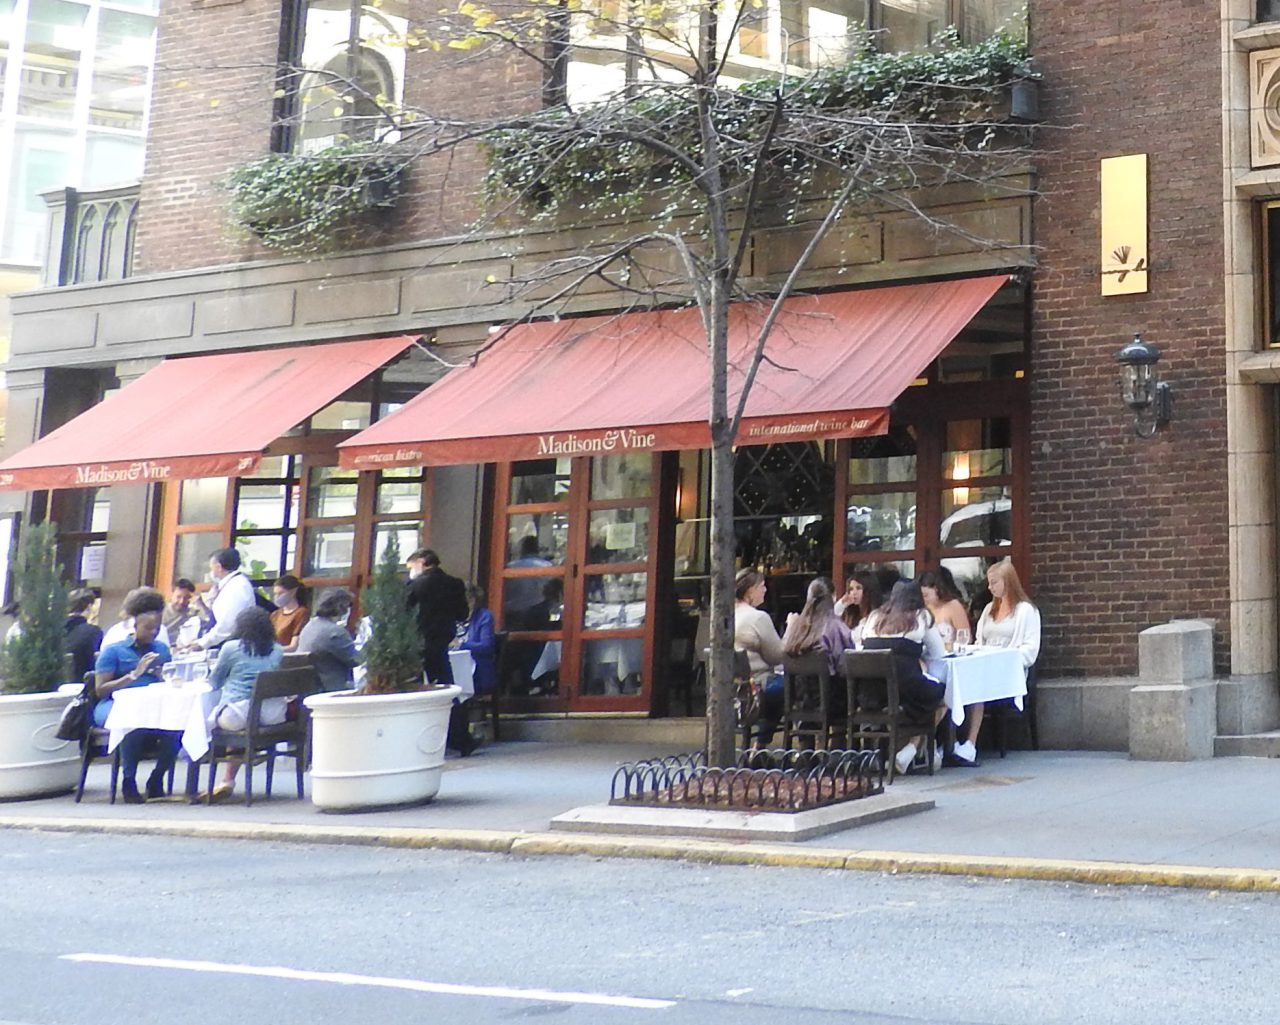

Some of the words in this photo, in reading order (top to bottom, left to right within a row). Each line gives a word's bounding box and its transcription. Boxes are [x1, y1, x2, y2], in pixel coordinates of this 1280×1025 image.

[749, 420, 818, 436] international
[820, 418, 847, 431] wine
[850, 417, 869, 430] bar
